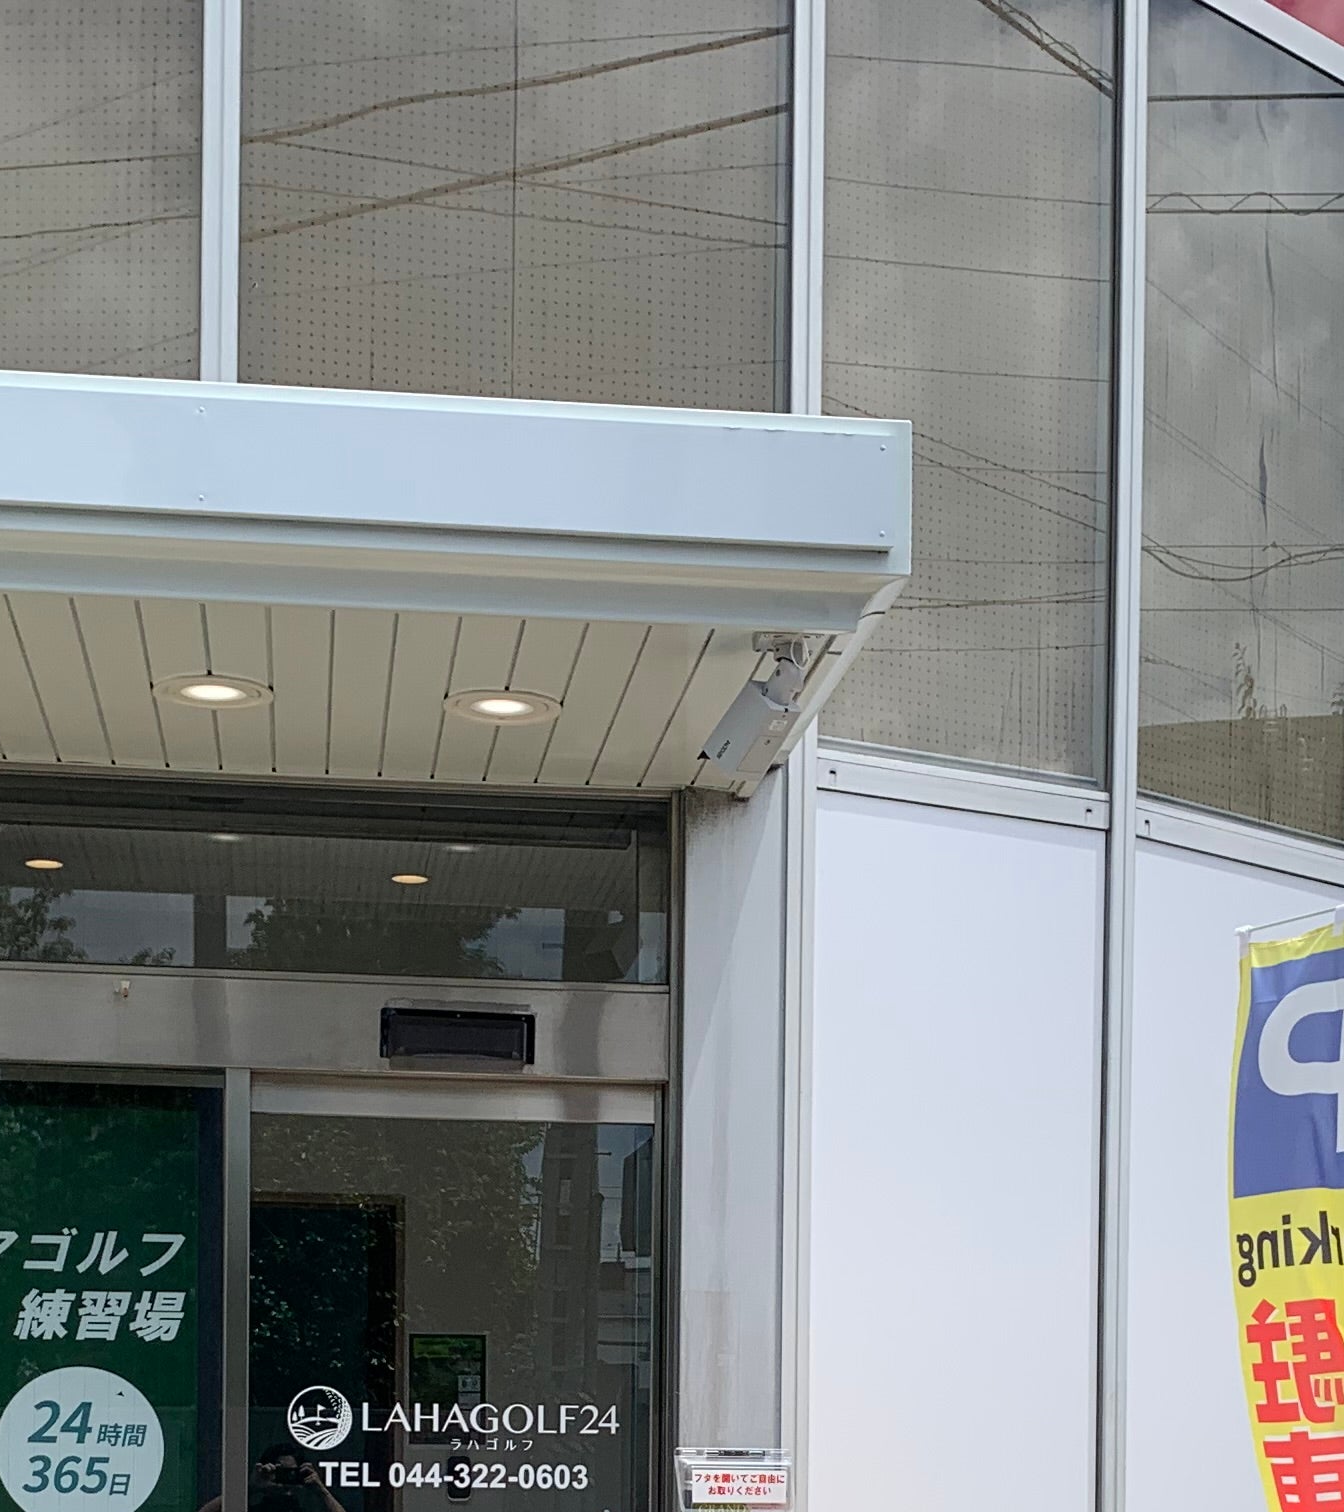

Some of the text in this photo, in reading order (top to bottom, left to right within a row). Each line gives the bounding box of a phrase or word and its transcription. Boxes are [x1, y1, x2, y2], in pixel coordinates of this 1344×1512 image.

[13, 1288, 187, 1342] 練習場
[27, 1400, 147, 1448] 24時間
[361, 1402, 620, 1436] LAHAGOLF24
[449, 1438, 535, 1451] ラハゴルフ
[22, 1454, 131, 1497] 365日
[319, 1461, 589, 1489] TEL 044-322-0603
[694, 1473, 785, 1484] フタを開いてご自由に
[708, 1486, 771, 1496] お取りください
